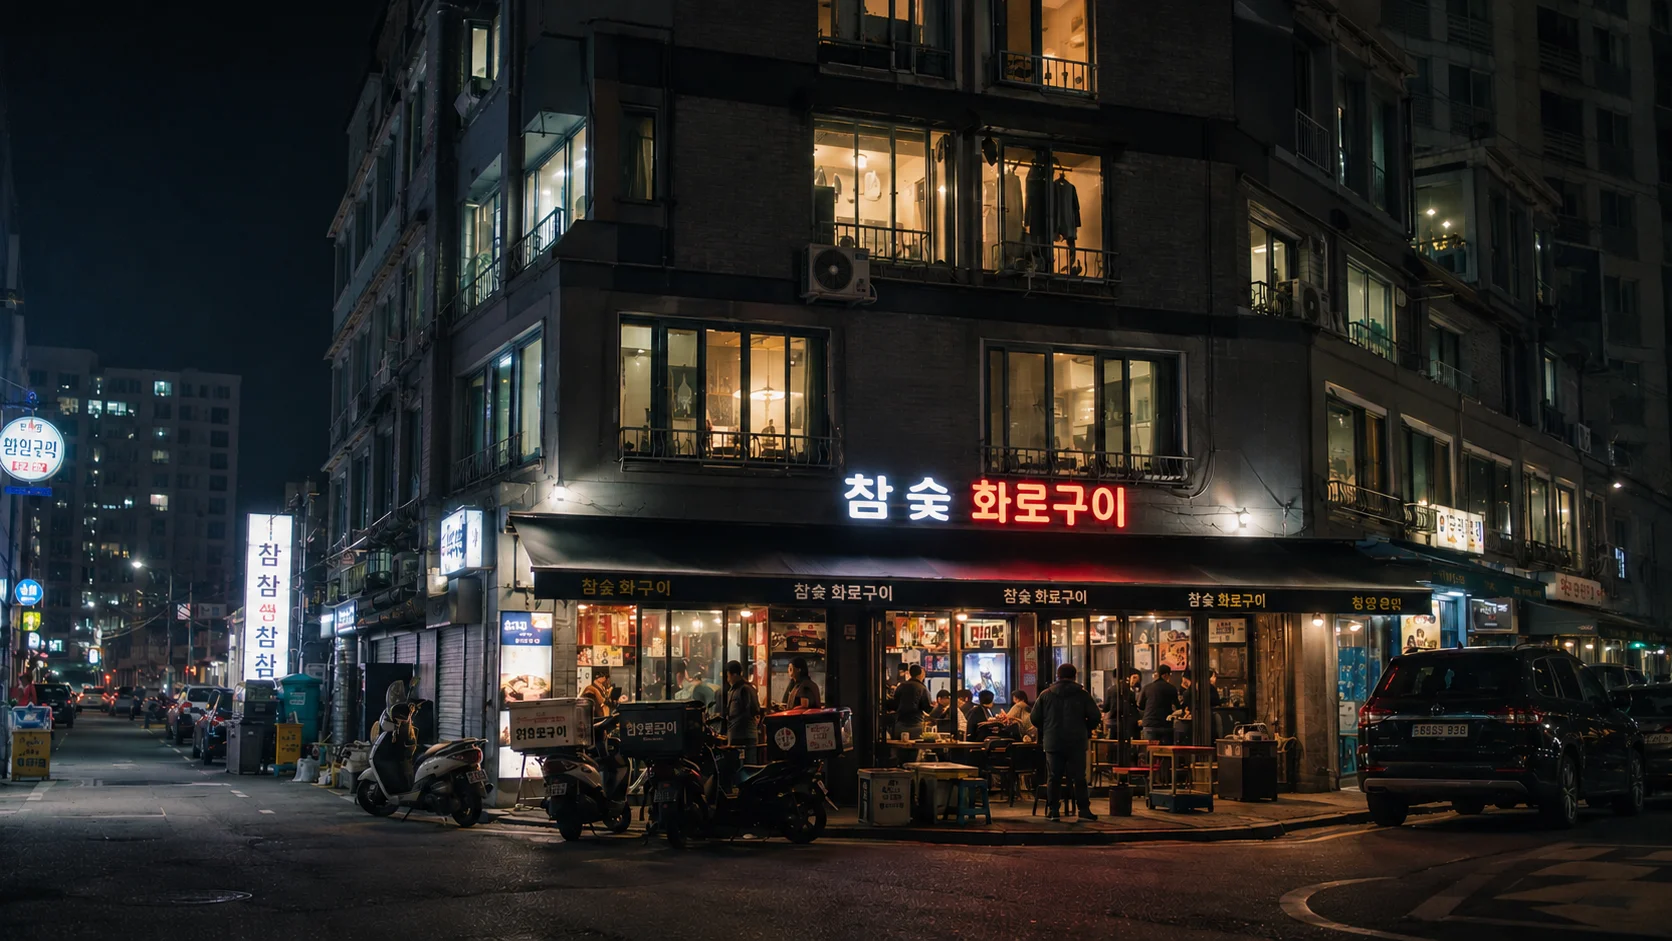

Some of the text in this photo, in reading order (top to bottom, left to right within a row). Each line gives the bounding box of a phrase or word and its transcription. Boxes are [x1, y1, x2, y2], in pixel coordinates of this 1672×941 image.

[844, 473, 894, 520] 참
[971, 479, 1125, 528] 화로구이
[831, 583, 893, 602] 화로구이
[1216, 592, 1266, 608] 화로구이
